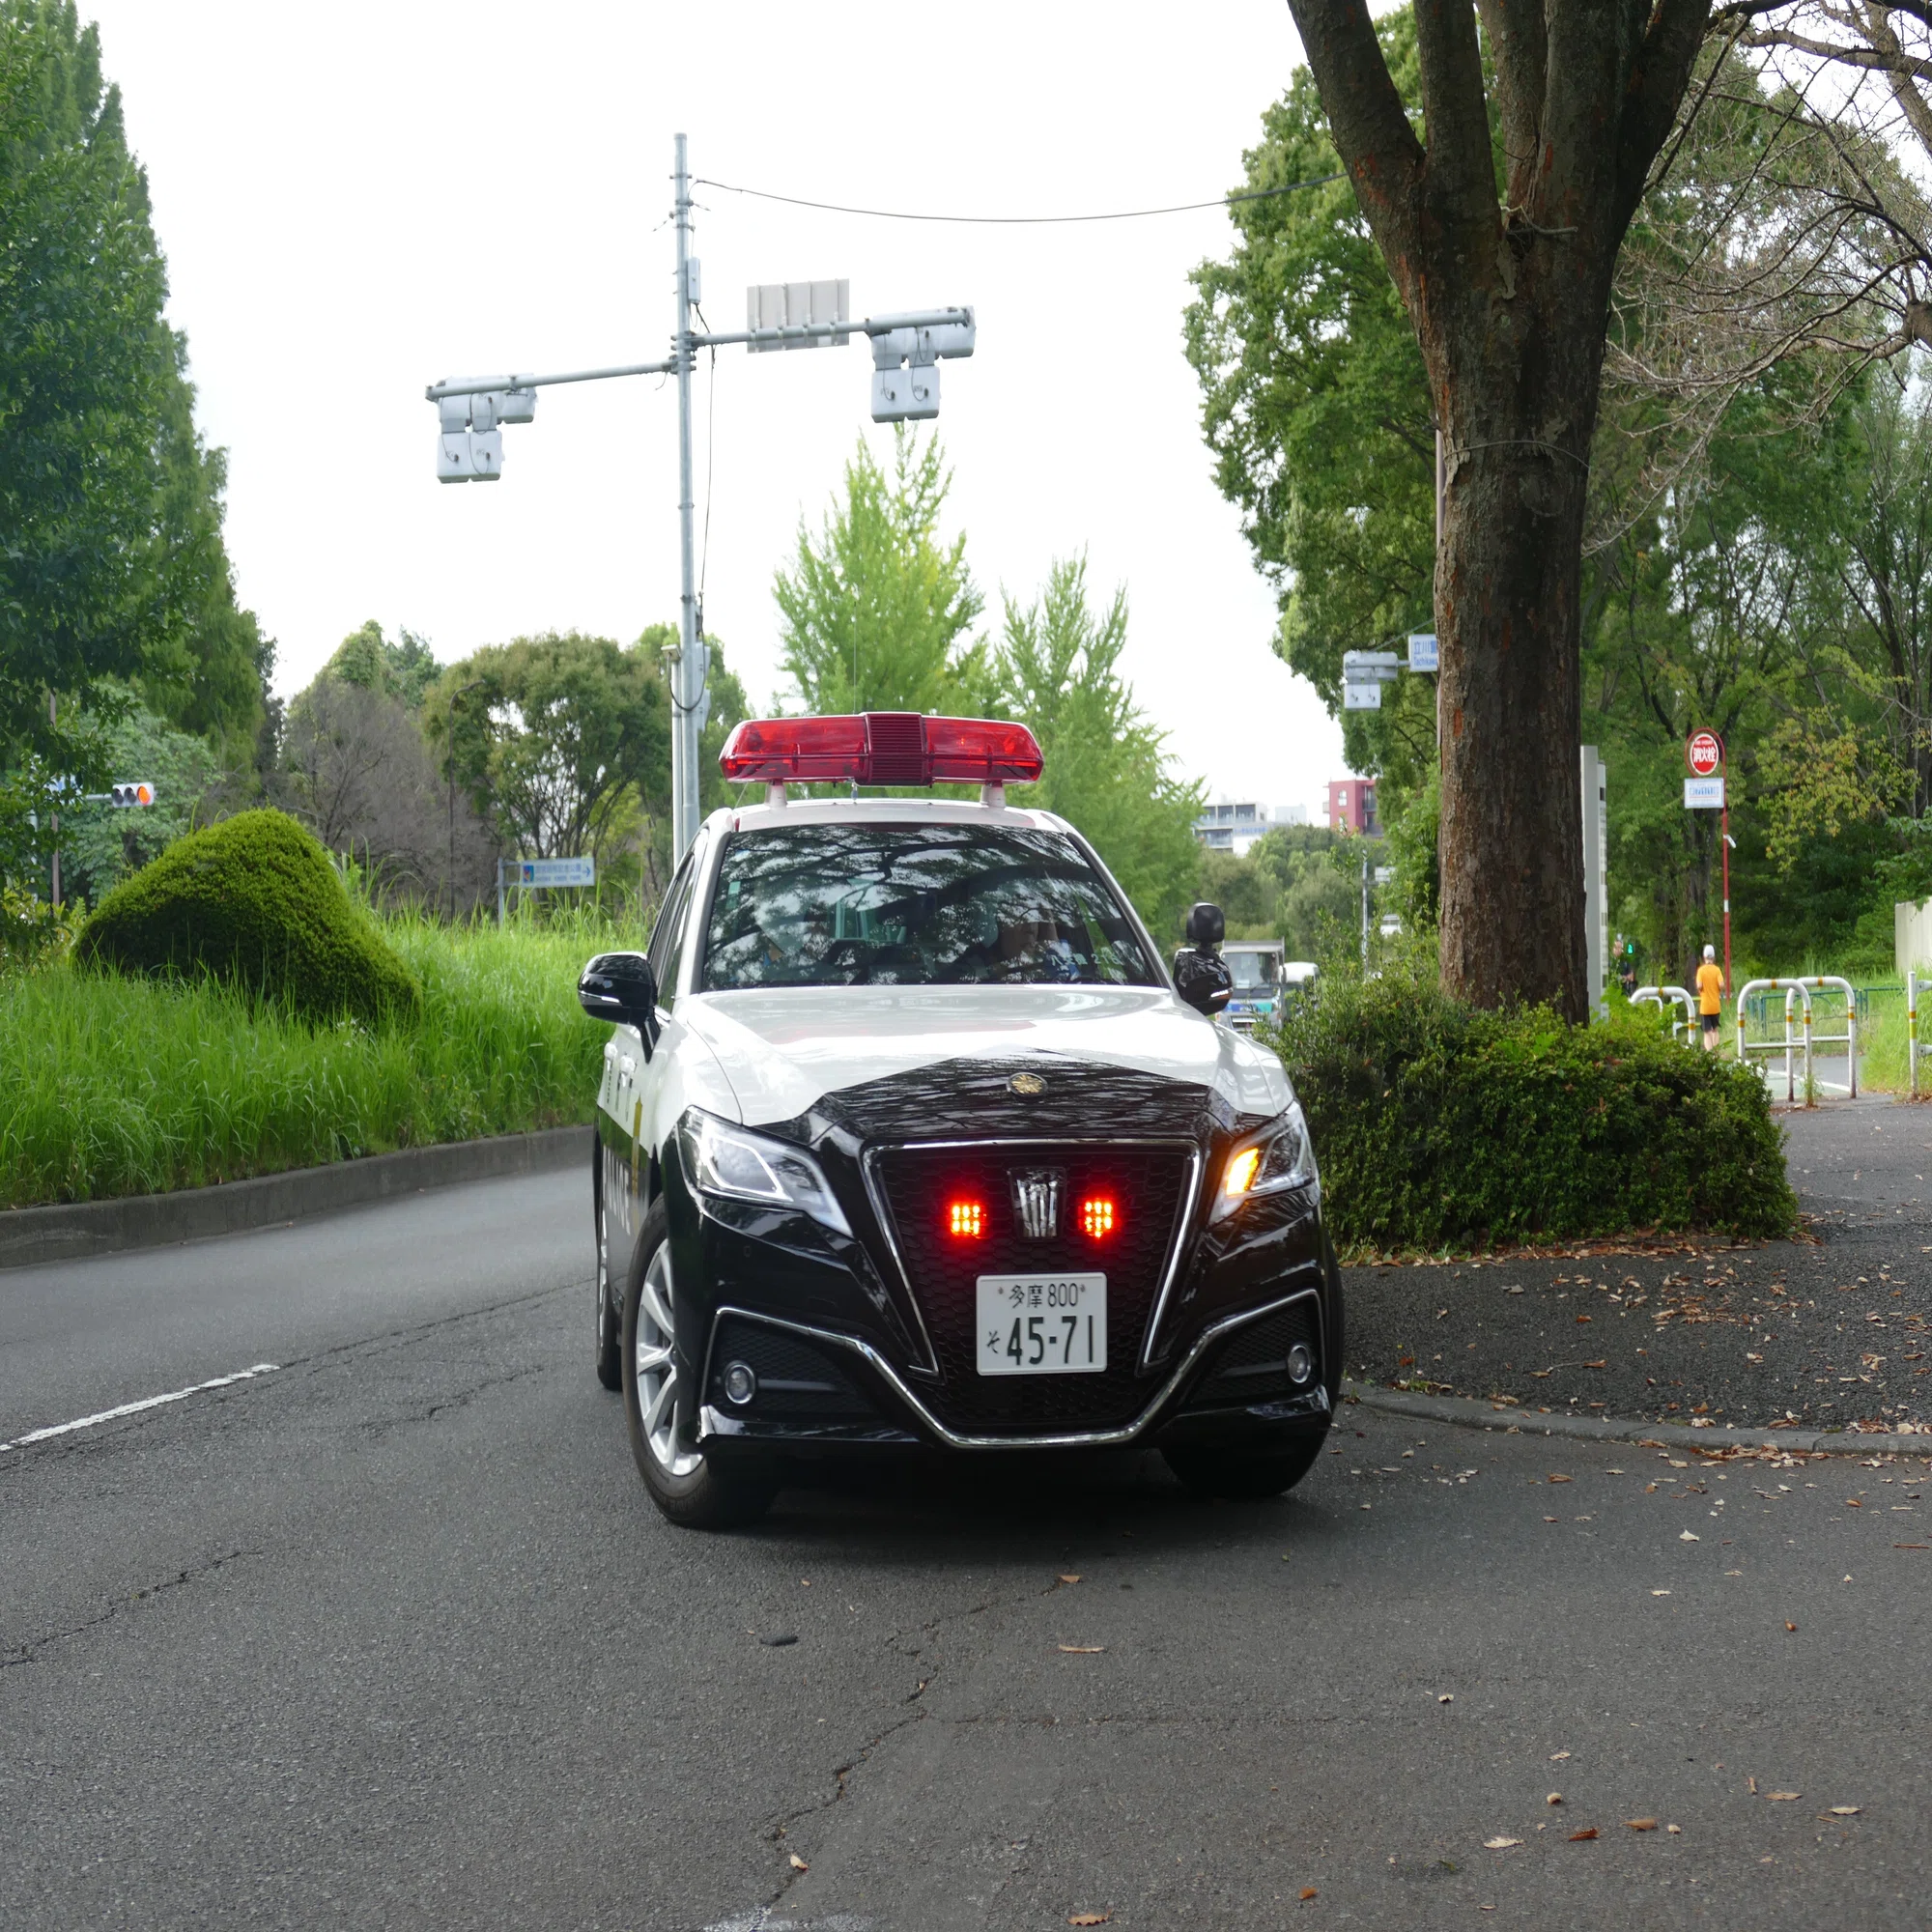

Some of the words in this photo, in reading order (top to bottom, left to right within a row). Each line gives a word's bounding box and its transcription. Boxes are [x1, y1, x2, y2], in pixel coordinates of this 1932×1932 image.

[1693, 746, 1717, 762] 消火栓
[1009, 1284, 1043, 1308] 多摩
[1047, 1282, 1078, 1307] 800
[986, 1330, 1001, 1354] そ
[1007, 1315, 1094, 1366] 45-71
